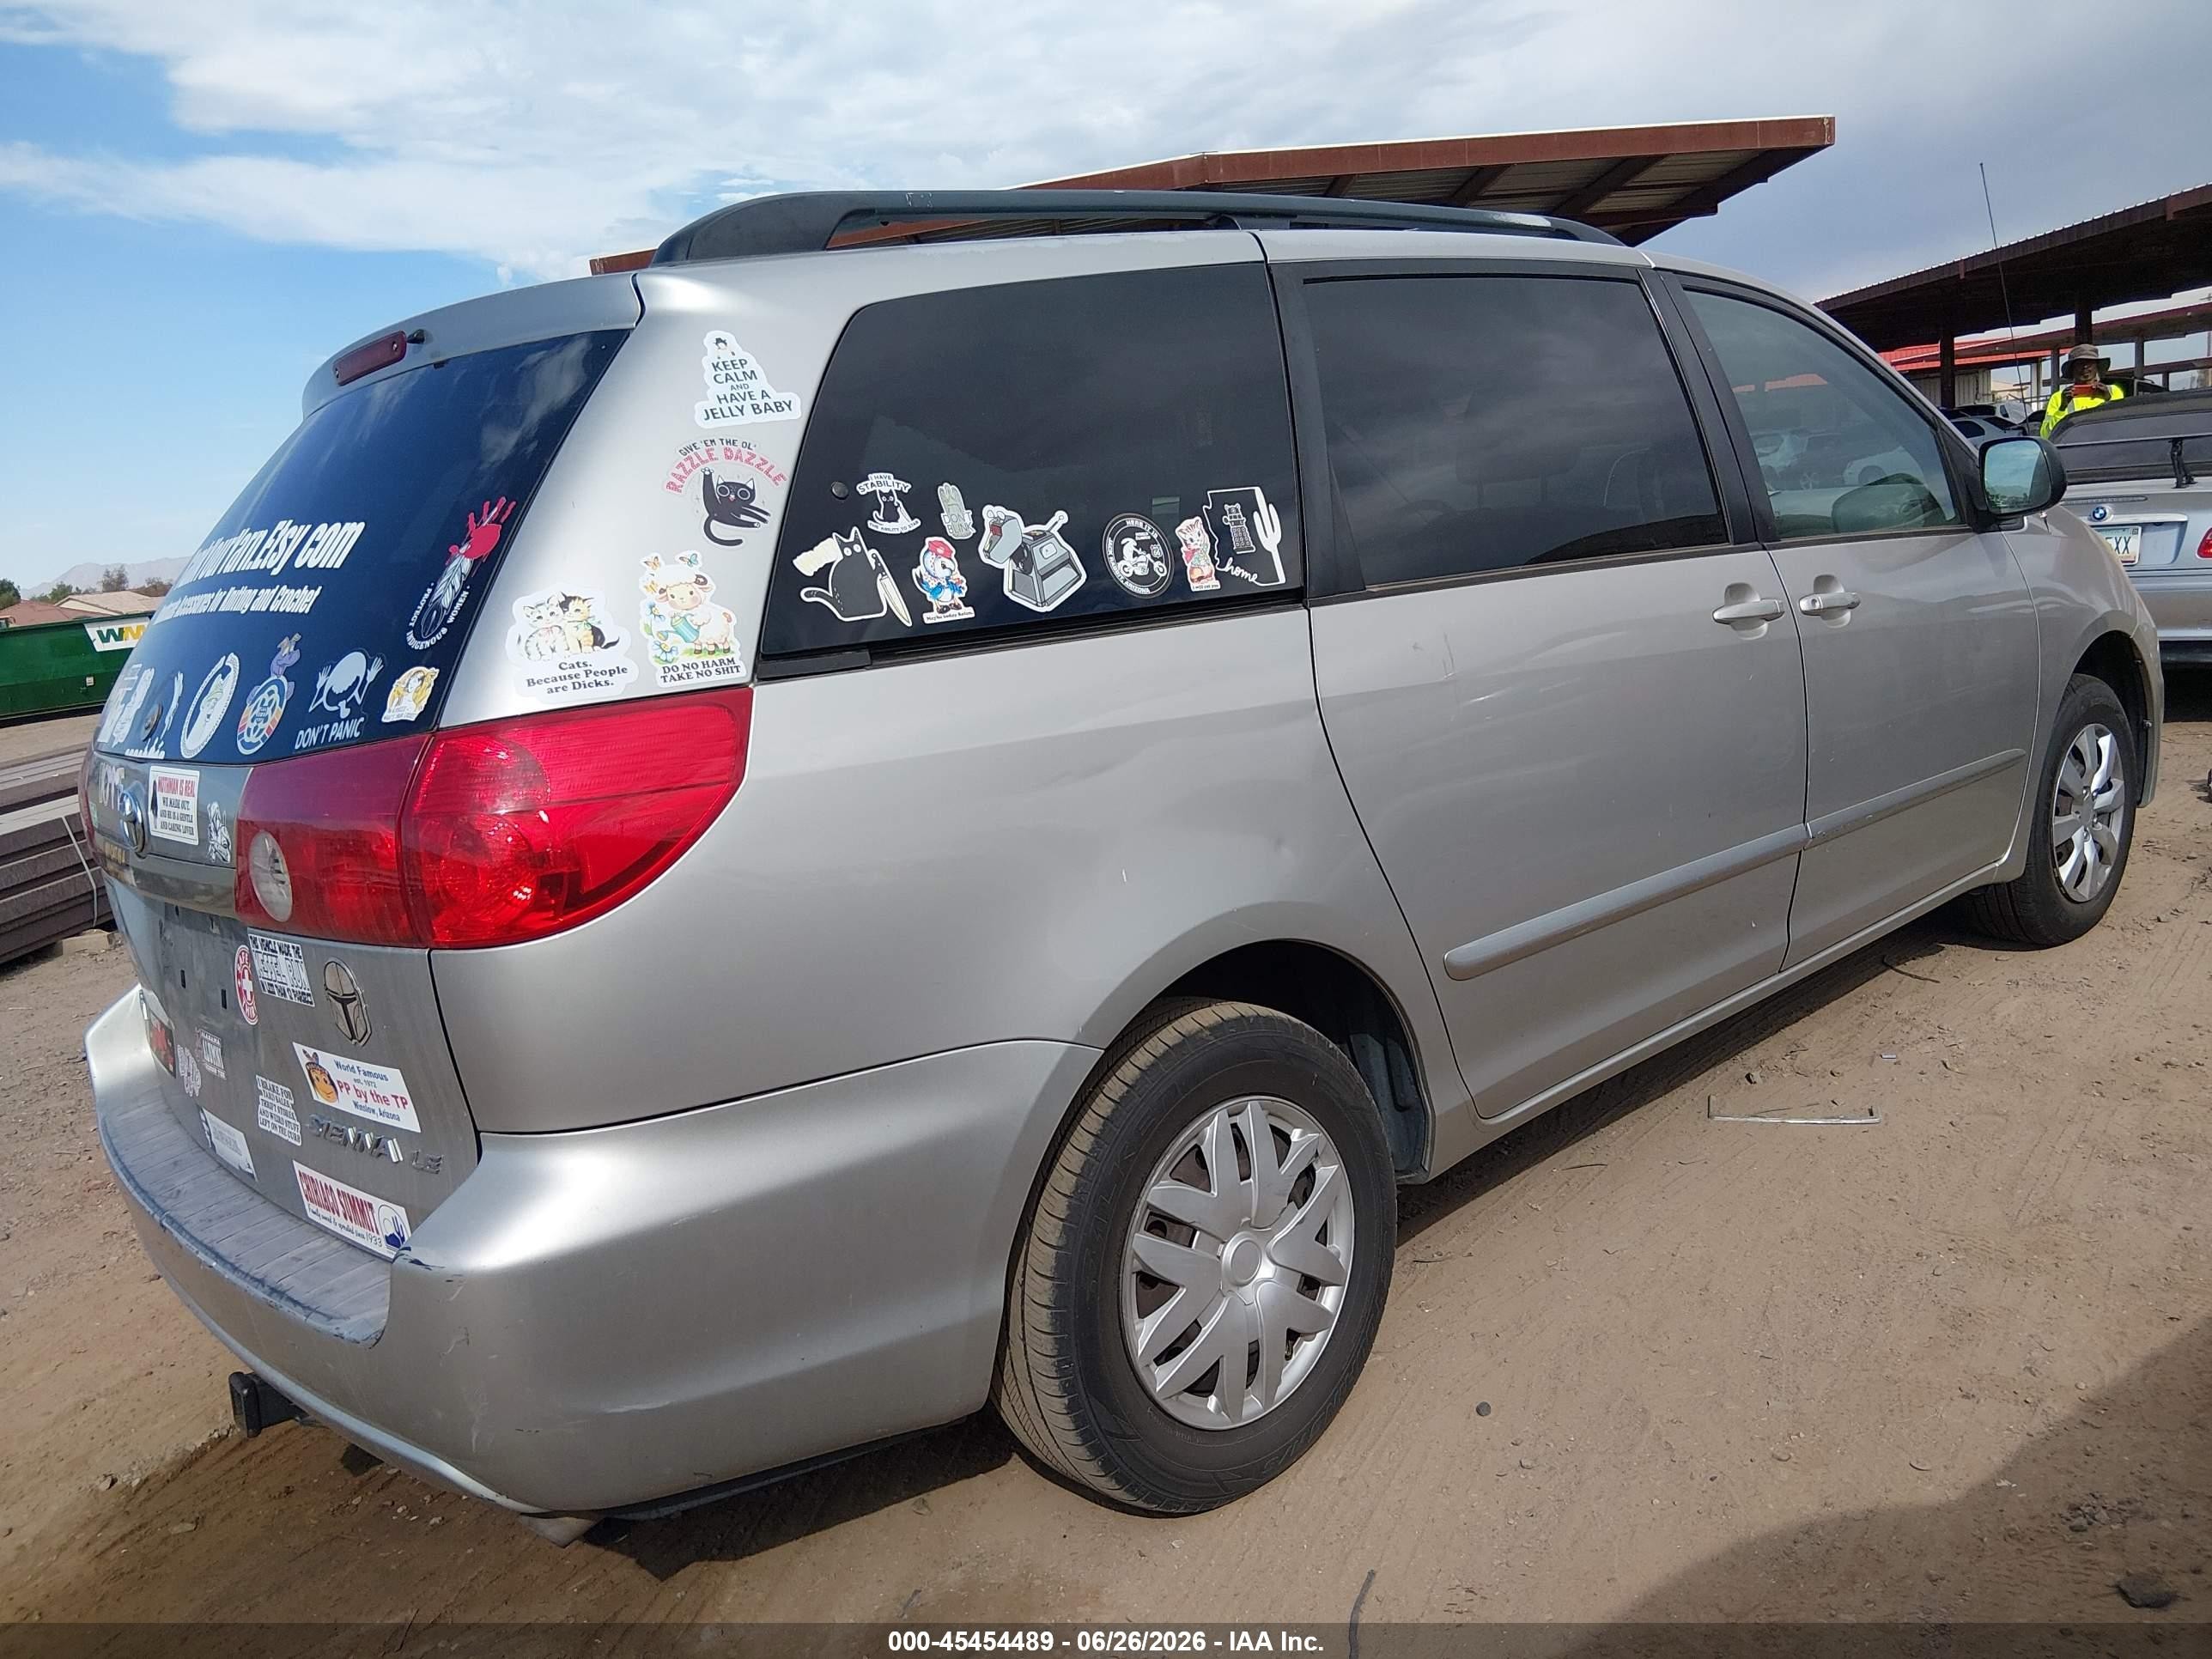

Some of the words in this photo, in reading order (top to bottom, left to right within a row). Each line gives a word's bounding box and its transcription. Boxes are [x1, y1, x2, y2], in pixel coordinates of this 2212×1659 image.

[711, 358, 747, 372] KEEP
[714, 370, 757, 384] CALM
[717, 392, 755, 404] HAVE
[760, 390, 771, 399] A
[703, 405, 745, 421] JELLY
[751, 400, 793, 415] BABY
[678, 442, 700, 457] GIVE
[720, 438, 738, 447] THE
[666, 447, 718, 494] RAZZLE
[724, 446, 787, 487] DAZZLE
[858, 481, 909, 493] STABILITY
[947, 522, 972, 535] BLINK
[2106, 536, 2130, 554] XX
[1225, 557, 1258, 581] home
[1125, 580, 1151, 595] ARIZONA
[218, 586, 258, 614] Knitting
[250, 585, 279, 611] and
[274, 585, 322, 613] Crochet
[410, 586, 433, 627] PROTECT
[447, 591, 470, 623] WOMEN
[96, 624, 145, 643] WM
[406, 627, 448, 650] INDIGENOUS
[558, 660, 592, 671] Cats.
[659, 672, 694, 684] TAKE
[696, 669, 714, 678] NO
[715, 665, 741, 676] SHIT
[662, 665, 679, 674] DO
[682, 661, 700, 672] NO
[702, 657, 736, 669] HARM
[526, 672, 580, 688] Because
[584, 665, 628, 679] People
[546, 683, 569, 694] are
[571, 678, 614, 691] Dicks.
[295, 724, 331, 750] DON'T
[328, 717, 365, 742] PANIC
[179, 779, 185, 795] IS
[185, 780, 196, 797] REAL
[169, 798, 180, 808] MADE
[179, 813, 193, 823] GENTLE
[182, 824, 194, 836] LOVER
[334, 1060, 356, 1073] World
[357, 1066, 388, 1081] Famous
[364, 1079, 377, 1089] 1972
[337, 1080, 351, 1095] PP
[354, 1085, 368, 1103] by
[370, 1089, 390, 1106] the
[392, 1094, 409, 1110] TP
[259, 1108, 269, 1118] AND
[352, 1100, 379, 1117] Winslow,
[379, 1109, 401, 1121] Arizona
[259, 1118, 270, 1129] LEFT
[307, 1114, 404, 1164] SIENNA
[412, 1150, 445, 1174] LE
[337, 1188, 380, 1236] SUMMIT
[366, 1232, 383, 1248] 1933
